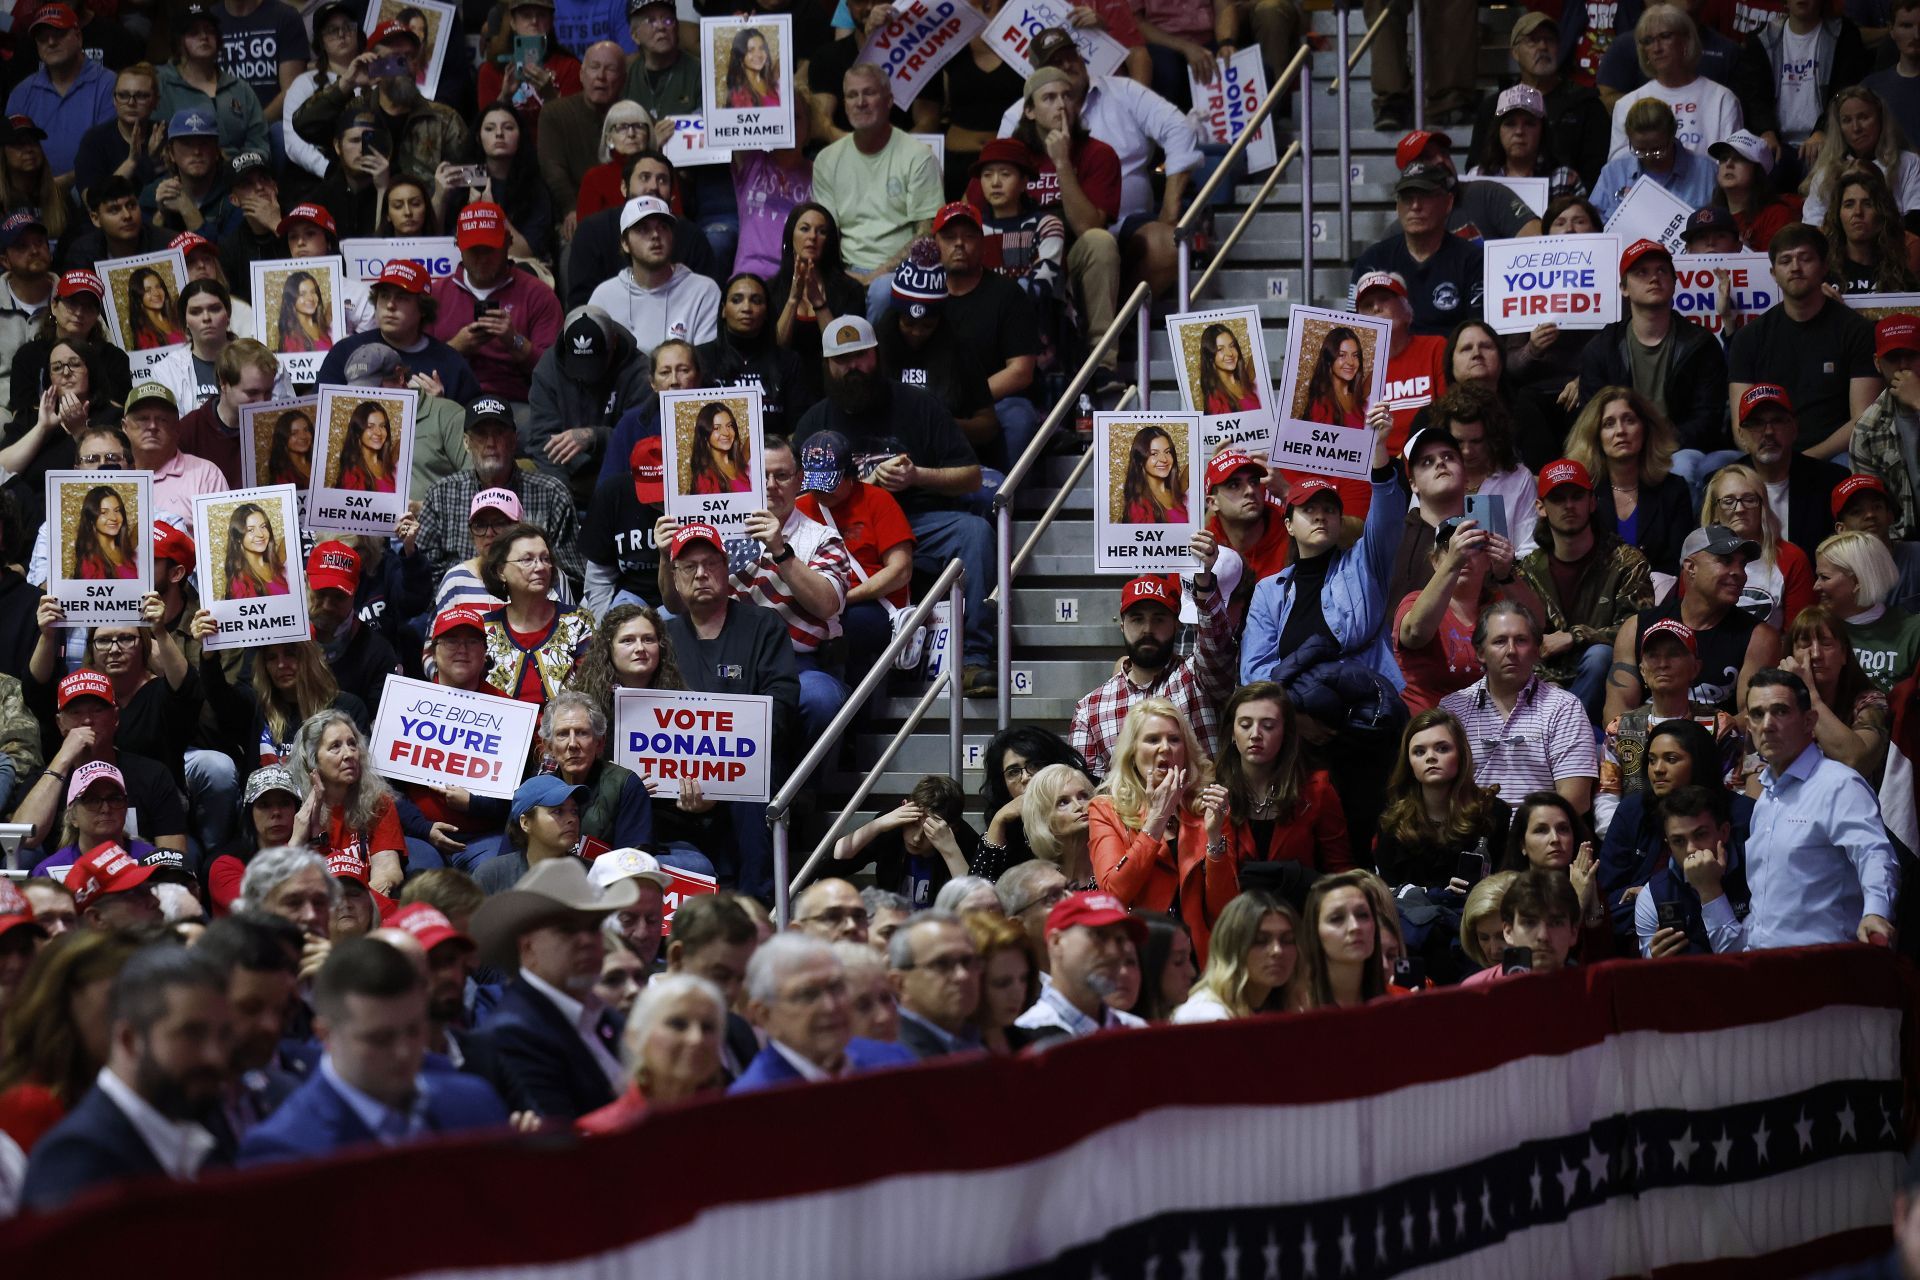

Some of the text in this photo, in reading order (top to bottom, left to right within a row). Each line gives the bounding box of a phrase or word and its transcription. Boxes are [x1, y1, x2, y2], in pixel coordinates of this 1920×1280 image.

[875, 0, 928, 51] VOTE
[250, 37, 277, 56] GO
[896, 18, 961, 82] TRUMP
[1206, 80, 1229, 144] TRUM
[1224, 66, 1245, 144] DONA
[737, 113, 760, 124] SAY
[715, 126, 740, 138] HER
[743, 125, 784, 137] NAME!
[1351, 167, 1360, 181] P
[1658, 212, 1686, 247] MBER
[1507, 250, 1593, 270] JOE BIDEN,
[66, 272, 84, 280] MAKE
[68, 277, 88, 285] GREAT
[897, 262, 948, 291] RUM
[1503, 269, 1595, 292] YOU'RE
[1676, 269, 1749, 289] VOE
[1272, 281, 1282, 295] N
[1502, 293, 1601, 318] FIRED!
[1672, 291, 1771, 311] ONLD
[289, 358, 313, 369] SAY
[131, 367, 151, 380] HER
[1383, 375, 1431, 401] UMP
[473, 399, 505, 413] TRUMP
[1216, 418, 1241, 431] SAY
[1311, 429, 1340, 444] SAY
[1283, 440, 1362, 463] HER NAME!
[1211, 454, 1229, 466] MAKE
[1217, 457, 1237, 472] GREAT
[345, 496, 373, 508] SAY
[476, 492, 513, 503] TRUMP
[702, 499, 730, 512] SAY
[318, 507, 396, 523] HER NAME!
[677, 512, 753, 526] HER NAME
[676, 525, 714, 541] MAKE AMERICA
[678, 530, 713, 543] GREAT AGAIN
[1135, 530, 1165, 543] SAY
[614, 529, 658, 555] TRU
[1107, 545, 1193, 558] HER NAME!
[322, 553, 354, 568] TRUMP
[86, 586, 115, 597] SAY
[1133, 581, 1168, 599] USA
[60, 600, 142, 612] HER NAME!
[239, 603, 267, 617] SAY
[1061, 602, 1072, 618] H
[442, 609, 480, 620] MAKE AMERICA
[217, 614, 296, 633] HER NAME!
[1662, 620, 1693, 636] AMERICA
[1669, 626, 1690, 639] AGAIN
[61, 672, 110, 689] MAKE AMERICA
[1015, 672, 1026, 689] G
[65, 682, 107, 697] GREAT AGAIN
[407, 699, 504, 731] JOE BIDEN,
[653, 708, 733, 732] VOTE
[400, 715, 502, 755] YOU'RE
[629, 731, 757, 758] DONALD
[389, 740, 503, 782] FIRED!
[967, 747, 979, 763] F
[79, 762, 117, 775] Trump
[254, 769, 290, 782] TRUMP
[639, 757, 746, 782] TRUMP
[144, 850, 184, 865] TRUMP
[334, 855, 365, 867] AMERICA
[341, 864, 362, 875] AGAIN
